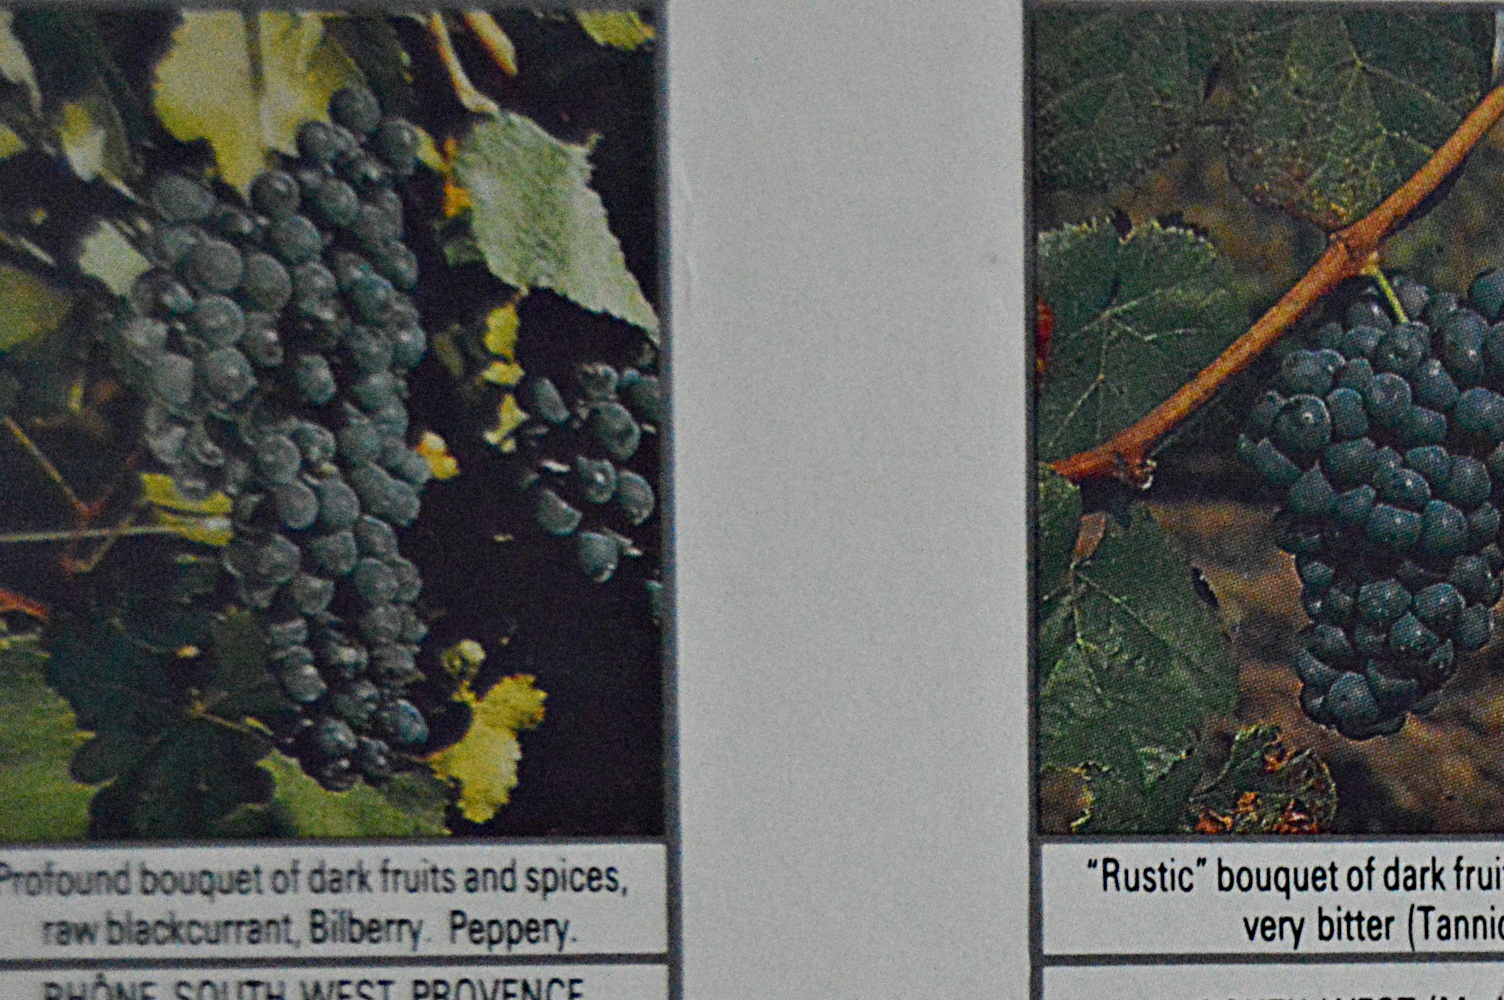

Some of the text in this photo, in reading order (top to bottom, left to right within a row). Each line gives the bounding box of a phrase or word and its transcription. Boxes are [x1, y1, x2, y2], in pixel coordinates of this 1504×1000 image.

[138, 862, 264, 901] bouquet
[269, 859, 301, 896] of
[307, 861, 373, 895] dark
[378, 859, 457, 895] fruits
[463, 859, 518, 894] and
[525, 859, 628, 901] spices,
[1216, 856, 1339, 899] bouquet
[1346, 855, 1376, 893] of
[1382, 855, 1447, 893] dark
[42, 907, 578, 953] raw blackcurrant, Bilberry. Peppery.
[1242, 915, 1306, 951] very
[1317, 905, 1396, 942] bitter
